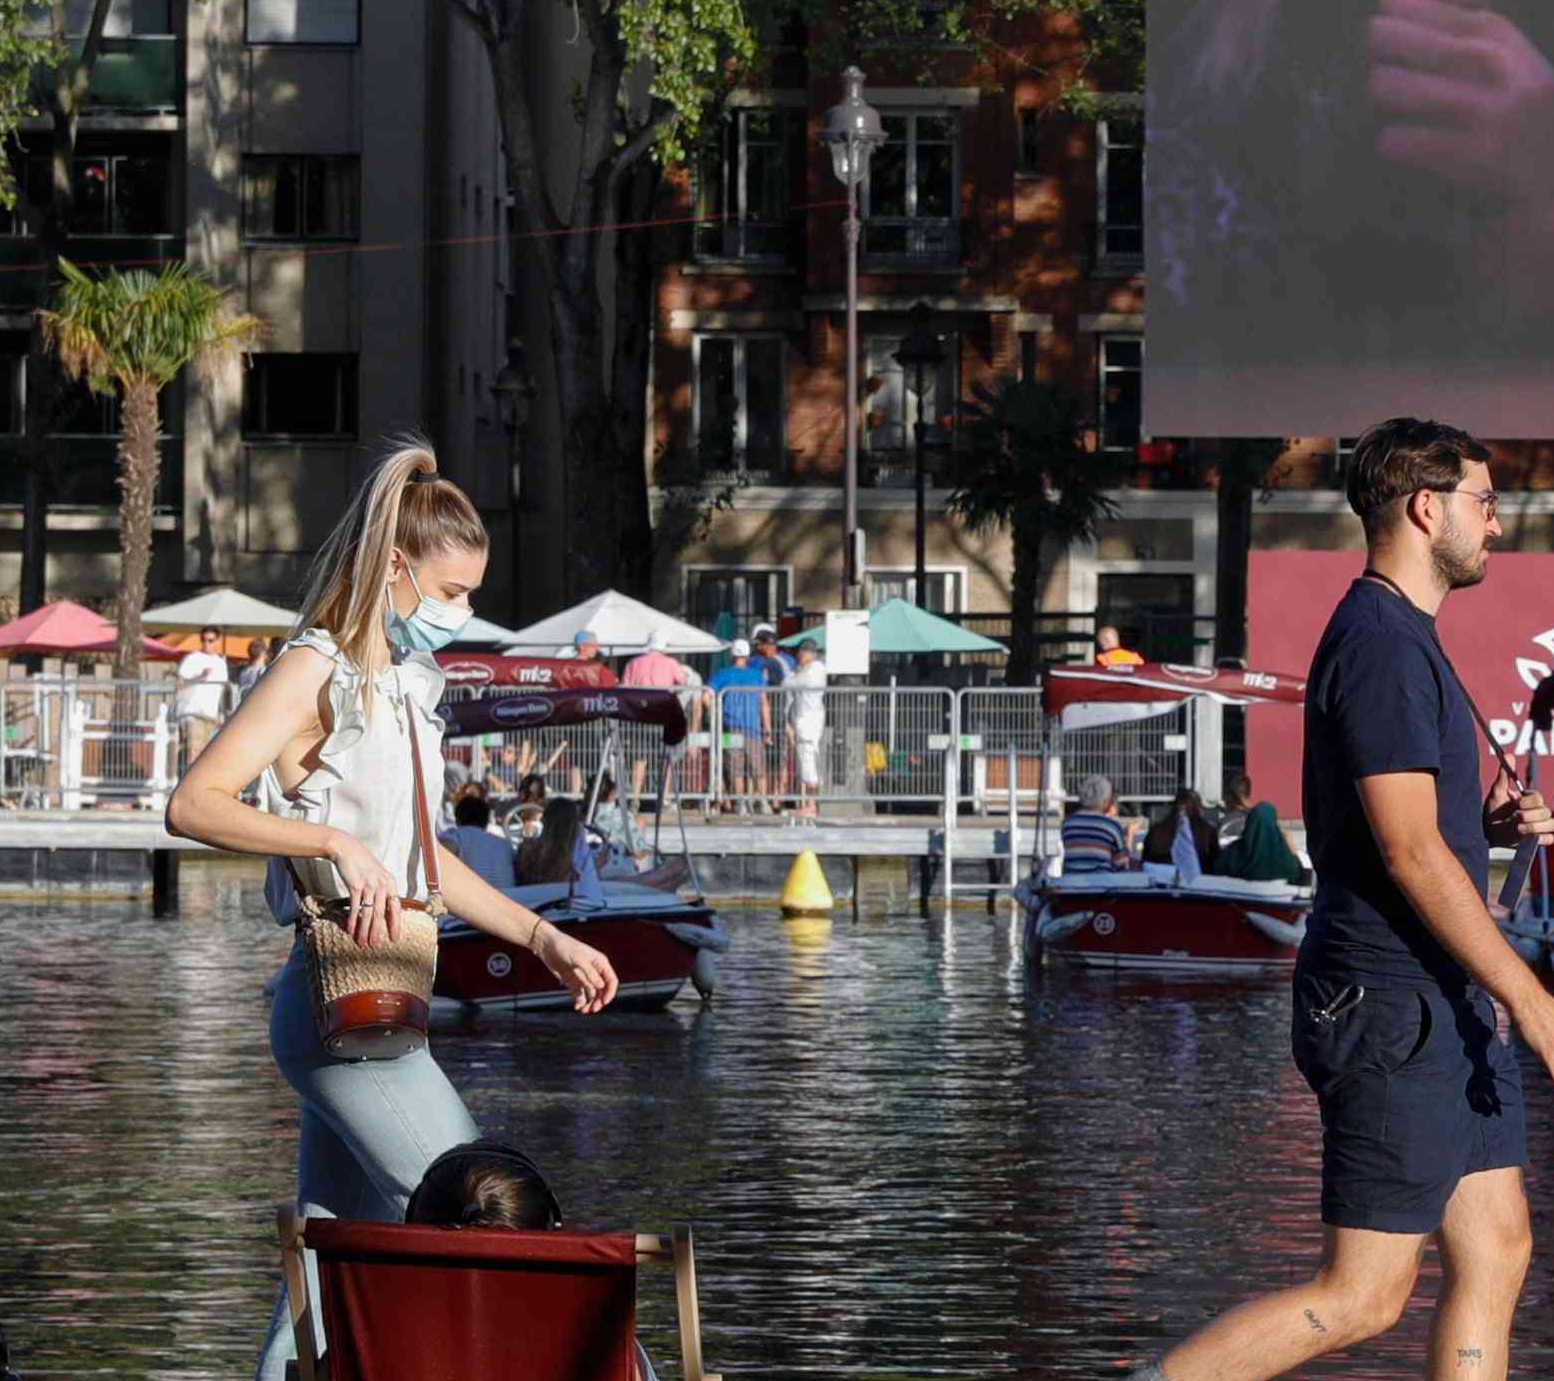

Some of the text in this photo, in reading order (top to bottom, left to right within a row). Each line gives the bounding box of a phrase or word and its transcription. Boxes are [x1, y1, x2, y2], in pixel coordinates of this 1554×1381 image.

[519, 666, 553, 682] mk2
[1242, 672, 1277, 689] mk2
[583, 693, 620, 712] mk2
